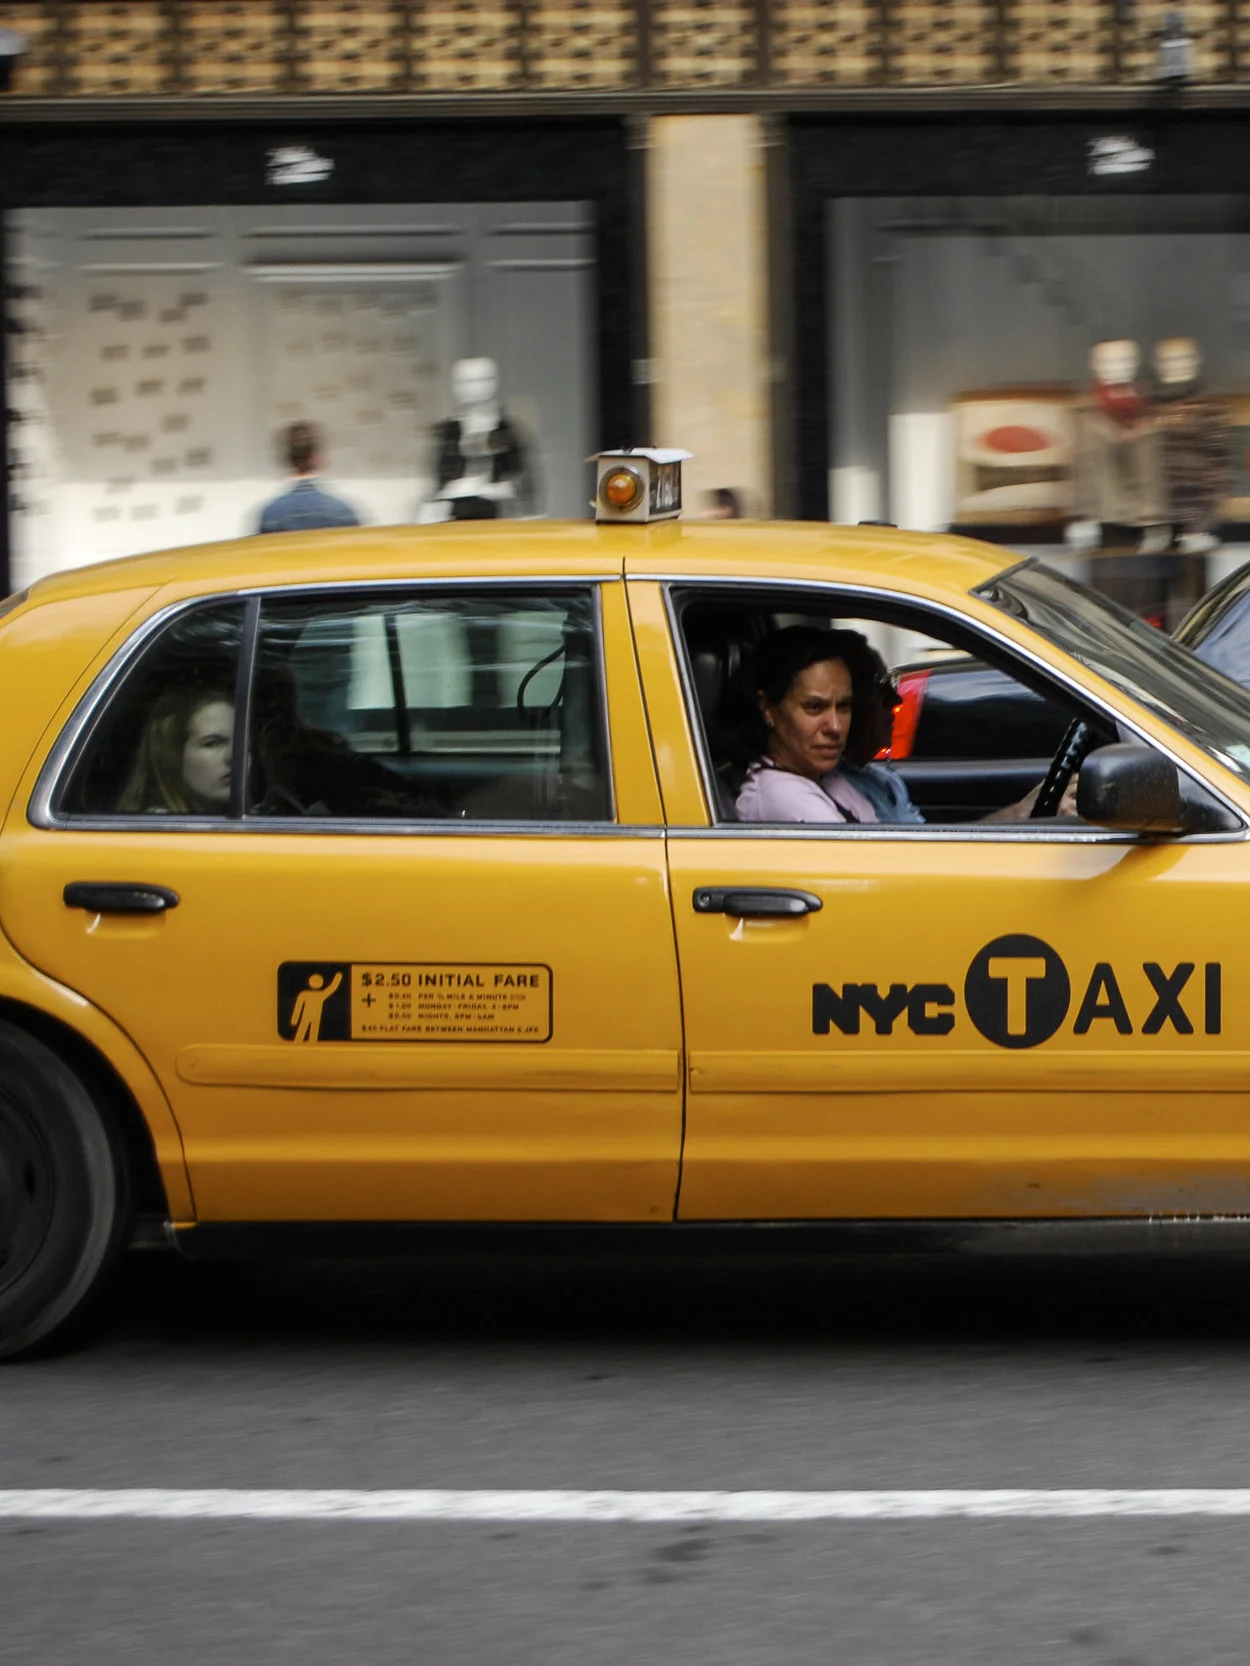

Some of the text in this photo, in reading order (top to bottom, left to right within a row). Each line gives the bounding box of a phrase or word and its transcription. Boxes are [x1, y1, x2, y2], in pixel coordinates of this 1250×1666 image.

[361, 972, 540, 988] $2.50 INITIAL FARE
[812, 956, 1222, 1036] NYC TAXI
